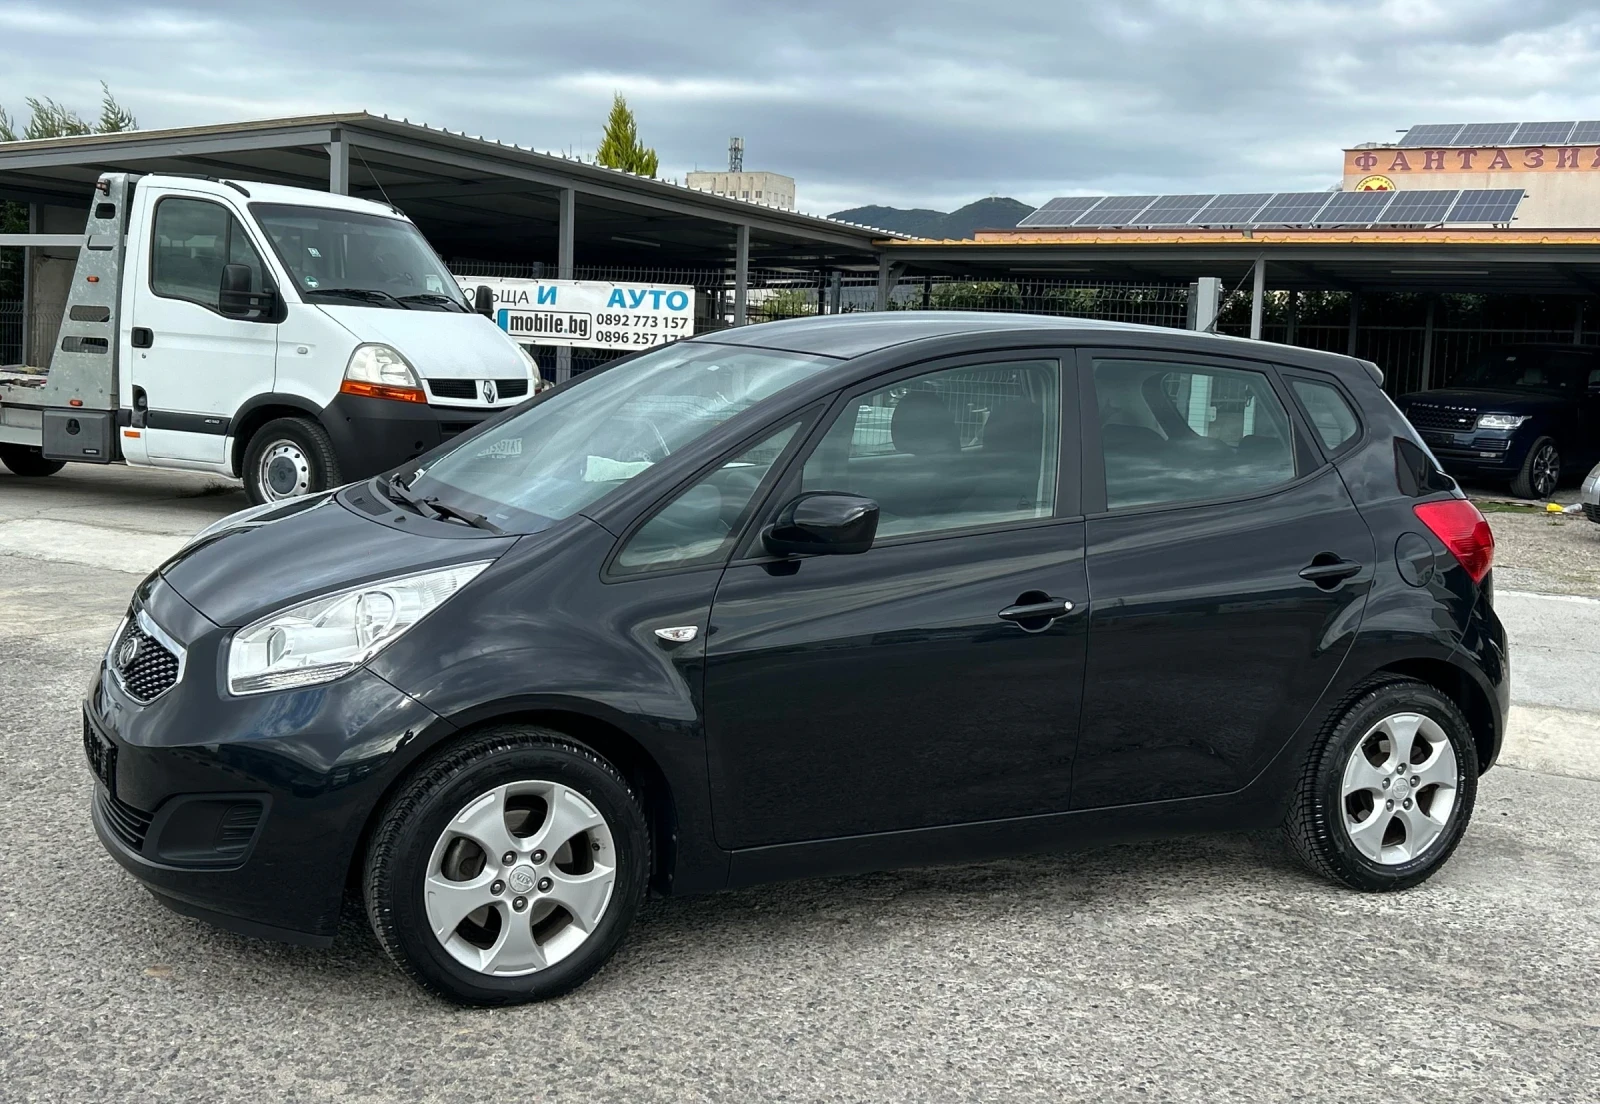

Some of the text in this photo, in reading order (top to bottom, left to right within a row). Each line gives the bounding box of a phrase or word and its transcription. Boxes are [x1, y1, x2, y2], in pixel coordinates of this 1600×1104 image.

[537, 285, 557, 305] И
[606, 288, 689, 311] АУТО
[510, 313, 588, 337] mobile.bg
[596, 313, 689, 329] 0892 773 157
[596, 331, 687, 345] 0896 257 17
